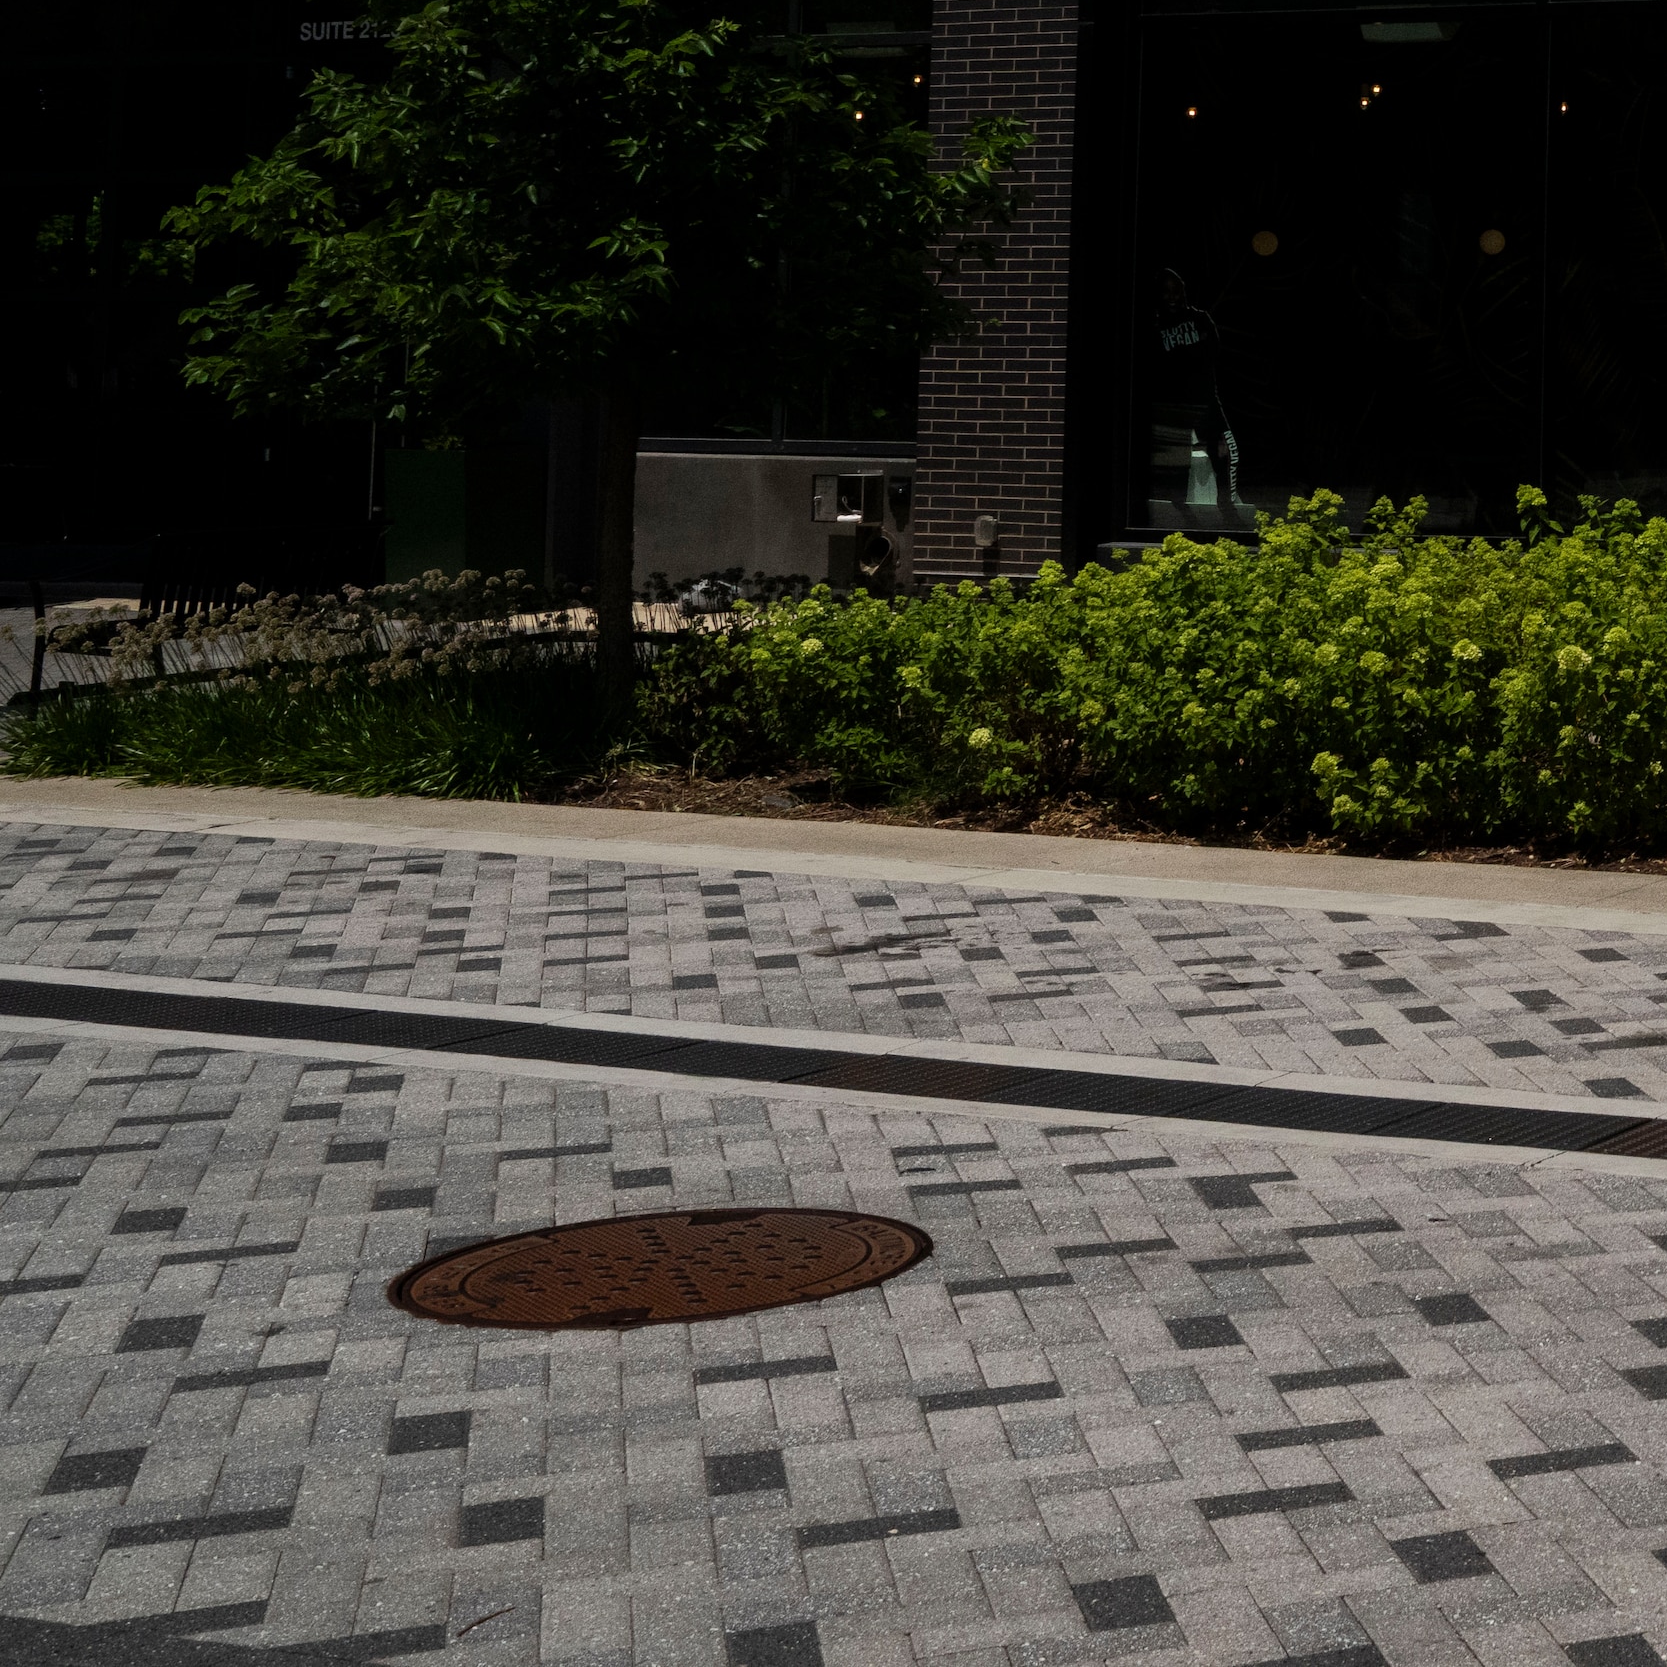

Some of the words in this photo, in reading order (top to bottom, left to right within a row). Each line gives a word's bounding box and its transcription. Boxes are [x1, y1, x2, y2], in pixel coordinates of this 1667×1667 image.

[299, 20, 355, 42] SUITE
[1160, 320, 1196, 339] SLUTTY
[1162, 330, 1200, 352] VEGAN
